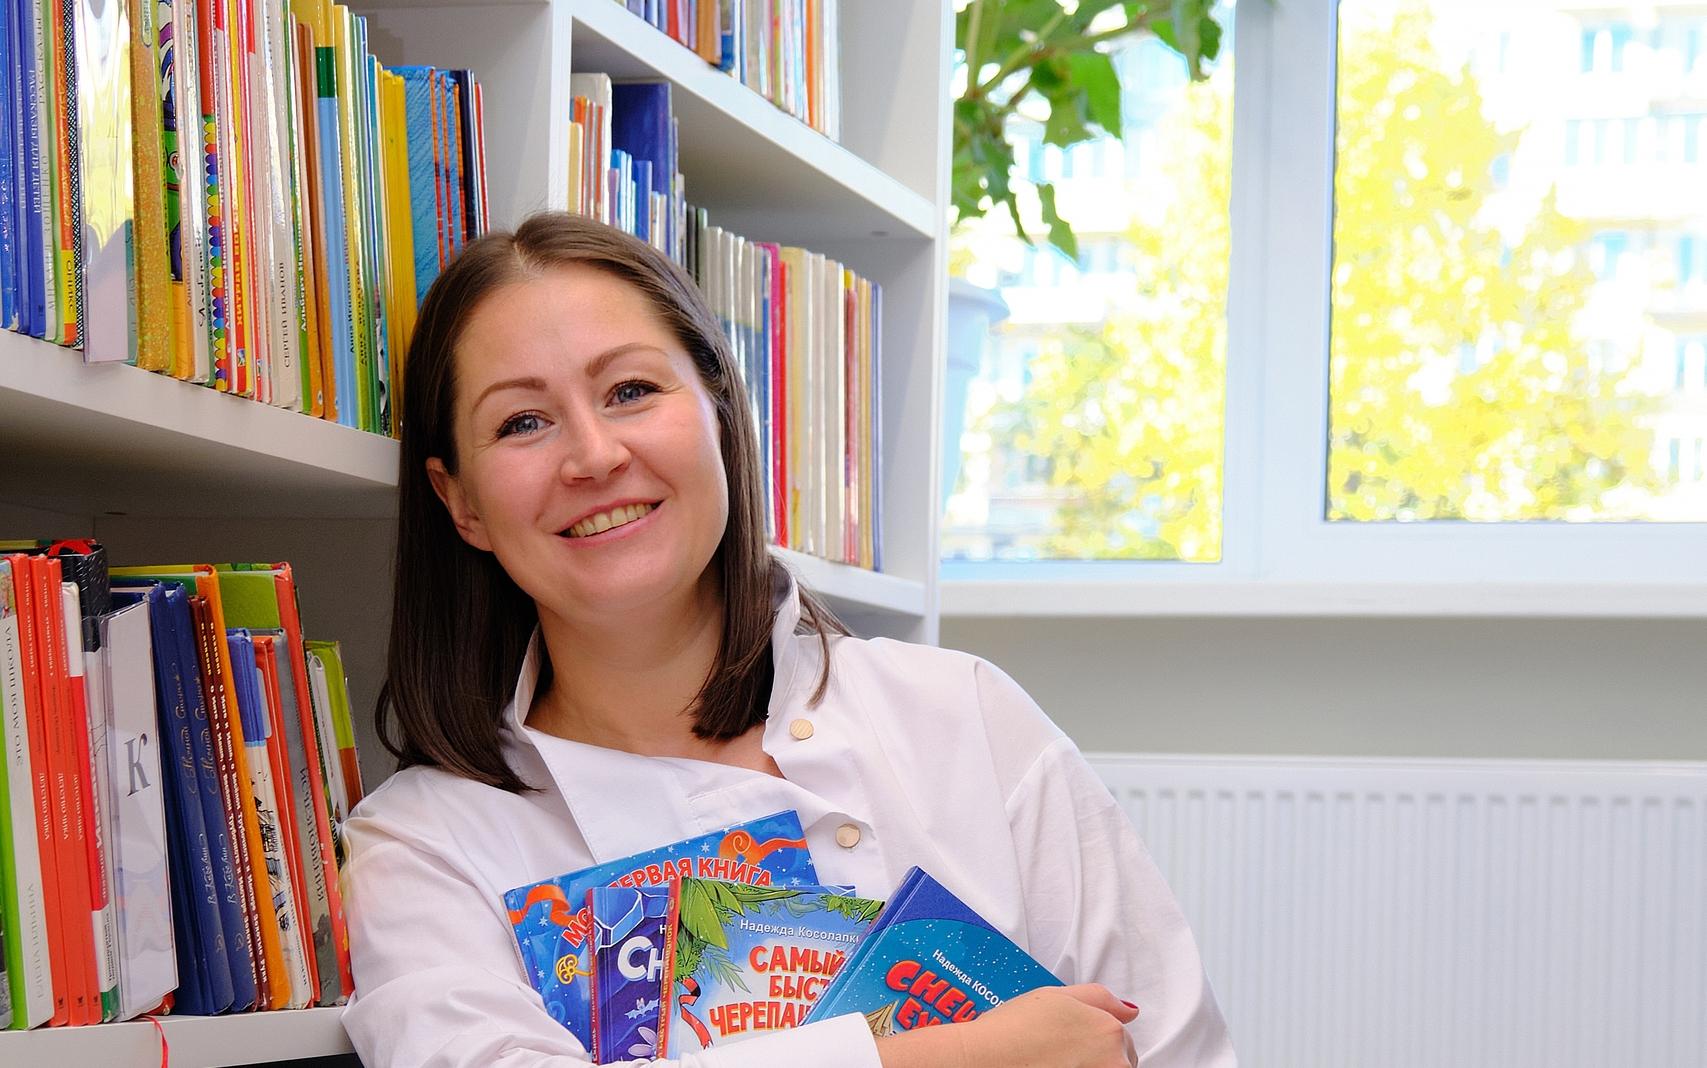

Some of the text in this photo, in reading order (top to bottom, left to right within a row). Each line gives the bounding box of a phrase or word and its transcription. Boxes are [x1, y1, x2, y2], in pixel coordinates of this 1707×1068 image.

[29, 69, 41, 213] РАССКАЗЫ ДЛЯ ДЕТЕЙ
[66, 259, 76, 315] ОНИКС
[223, 271, 231, 330] Альберт
[234, 261, 243, 326] ХИТРАЯ
[278, 262, 290, 368] СЕРГЕЙ ИВАНОВ
[299, 274, 307, 332] Альберт
[11, 693, 20, 728] МОЯ
[123, 733, 151, 796] К
[300, 767, 325, 902] ИСЧЕЗНОВЕНИЯ
[561, 857, 773, 949] МО ЕРВАЯ КНИГА
[740, 919, 794, 937] Надежда
[748, 945, 846, 975] САМЫЙ
[768, 975, 830, 1001] БЫСТ
[932, 949, 972, 987] Надежда
